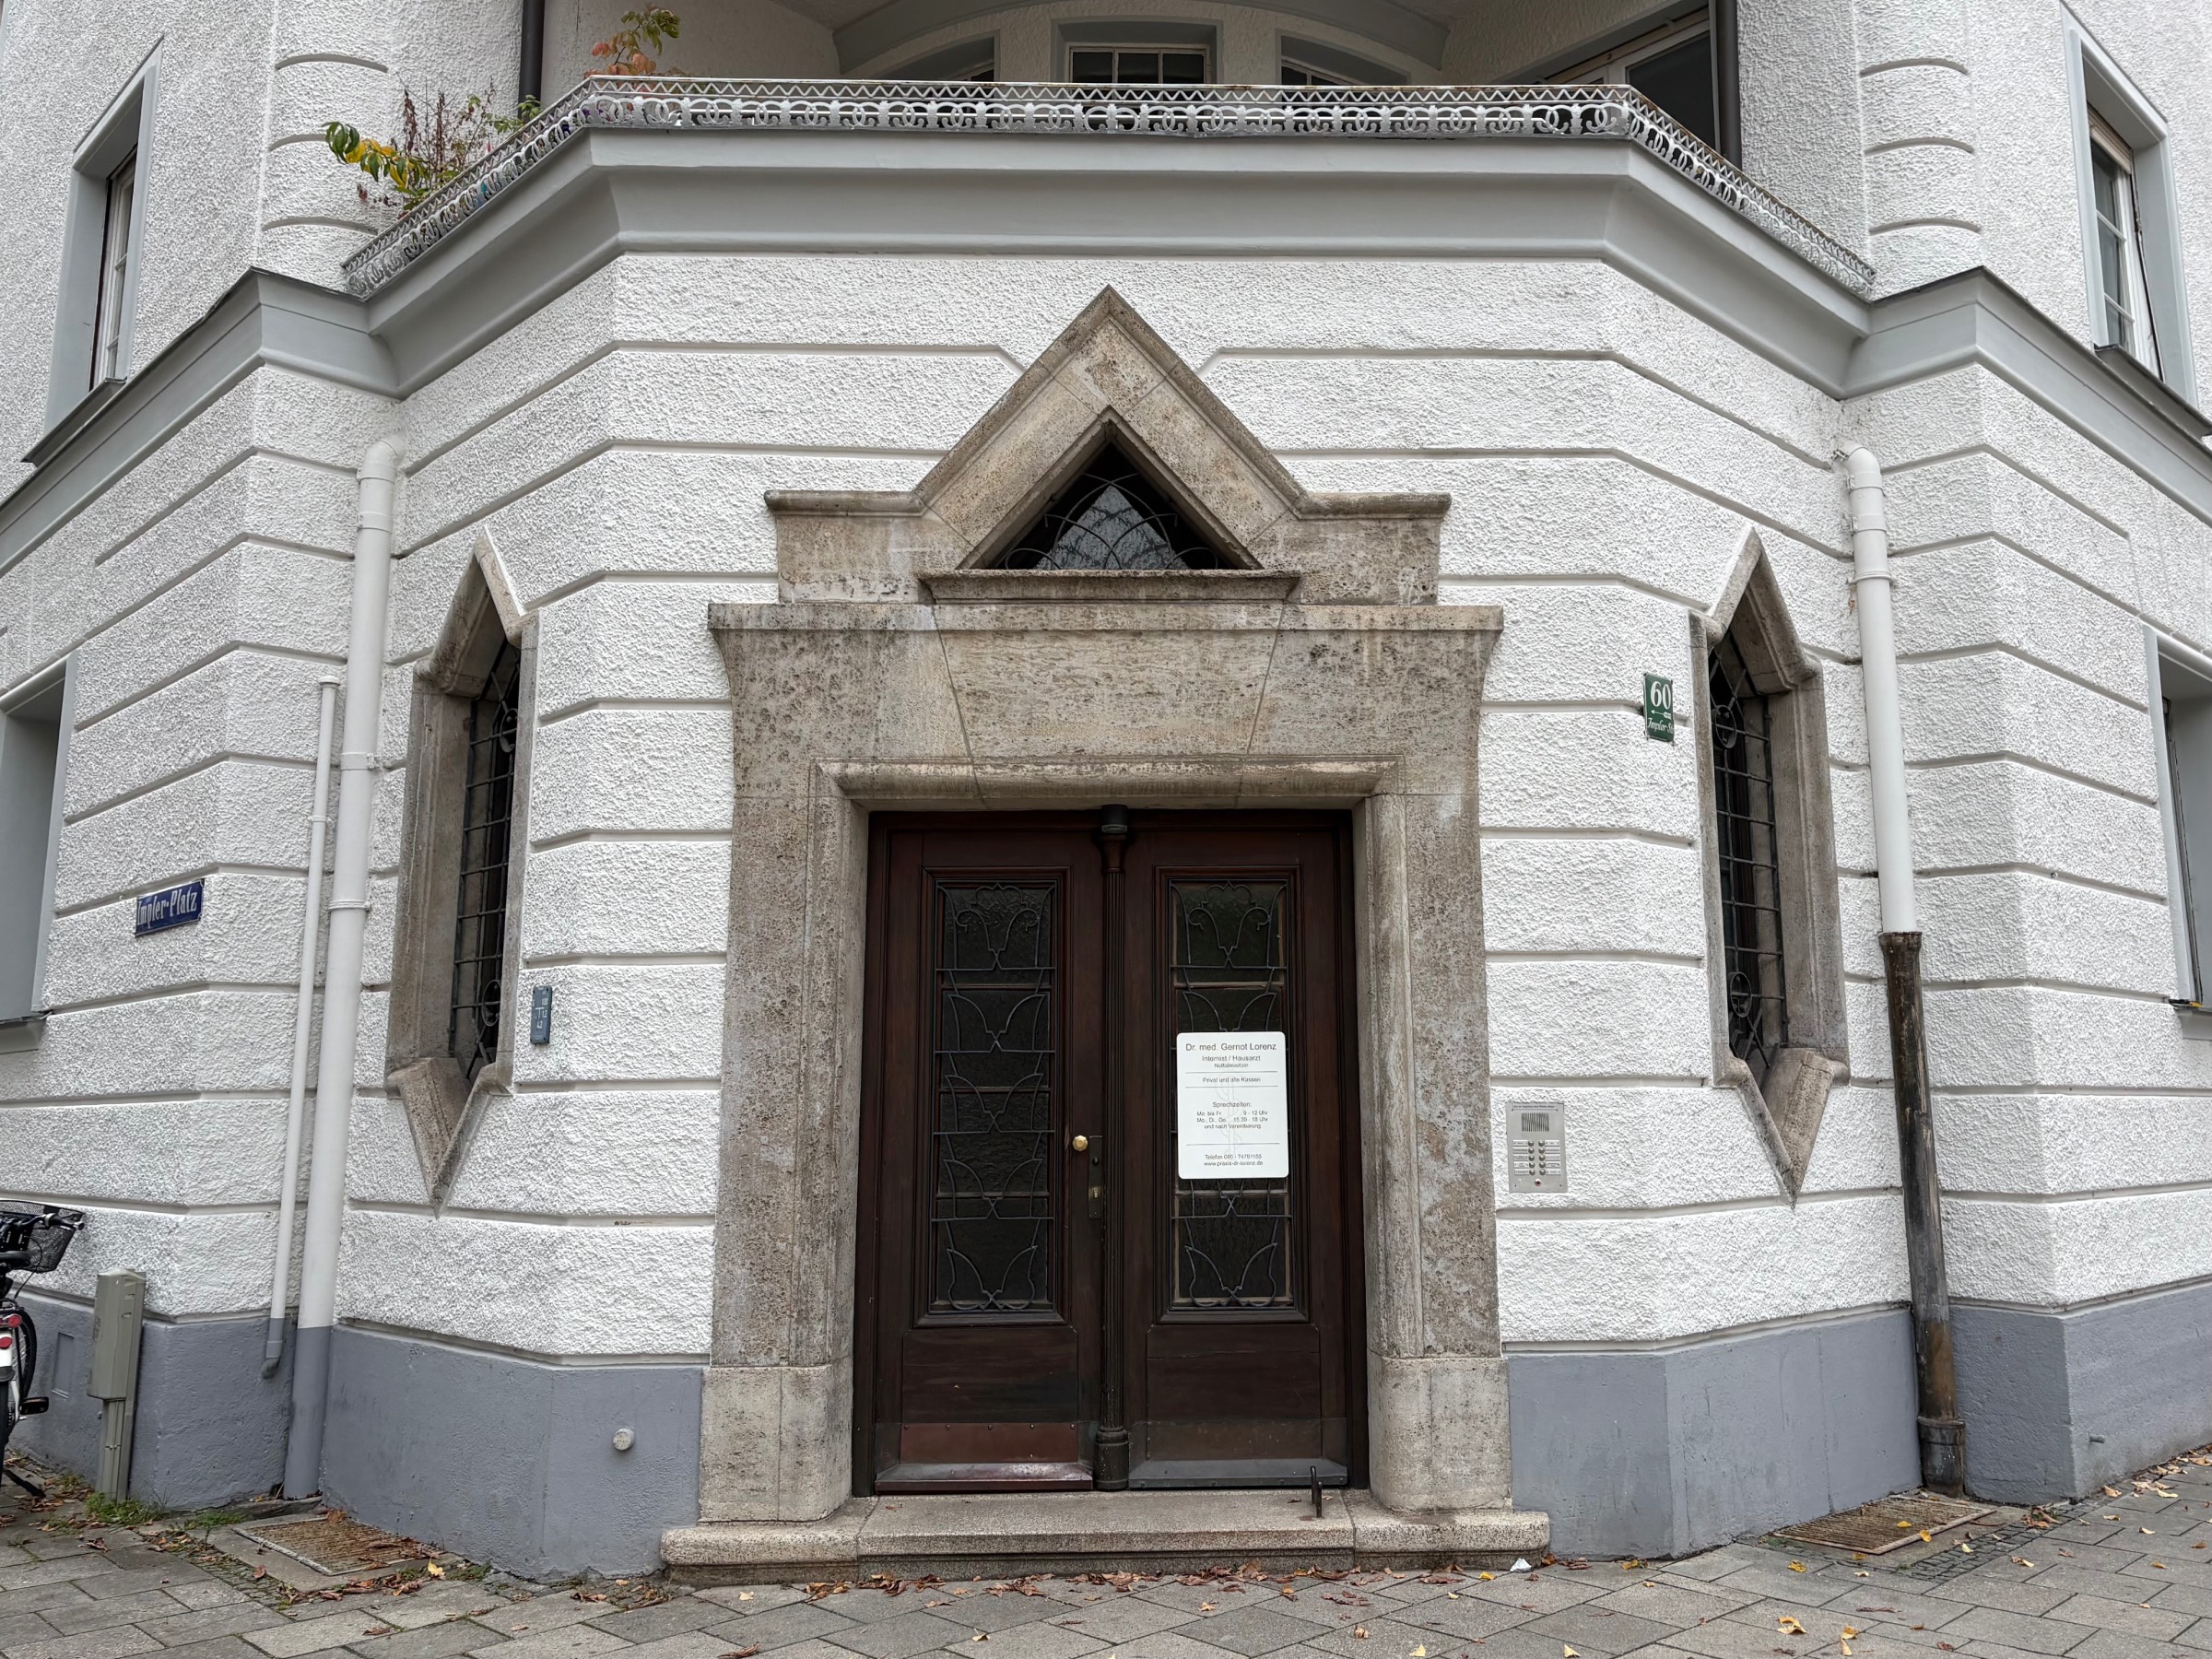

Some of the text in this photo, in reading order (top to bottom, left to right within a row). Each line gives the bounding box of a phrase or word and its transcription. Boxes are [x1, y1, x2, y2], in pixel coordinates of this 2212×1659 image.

[1651, 681, 1671, 710] 60
[137, 887, 197, 929] Impler-Platz
[1220, 1042, 1248, 1051] Gernot
[1249, 1042, 1277, 1051] Lorenz
